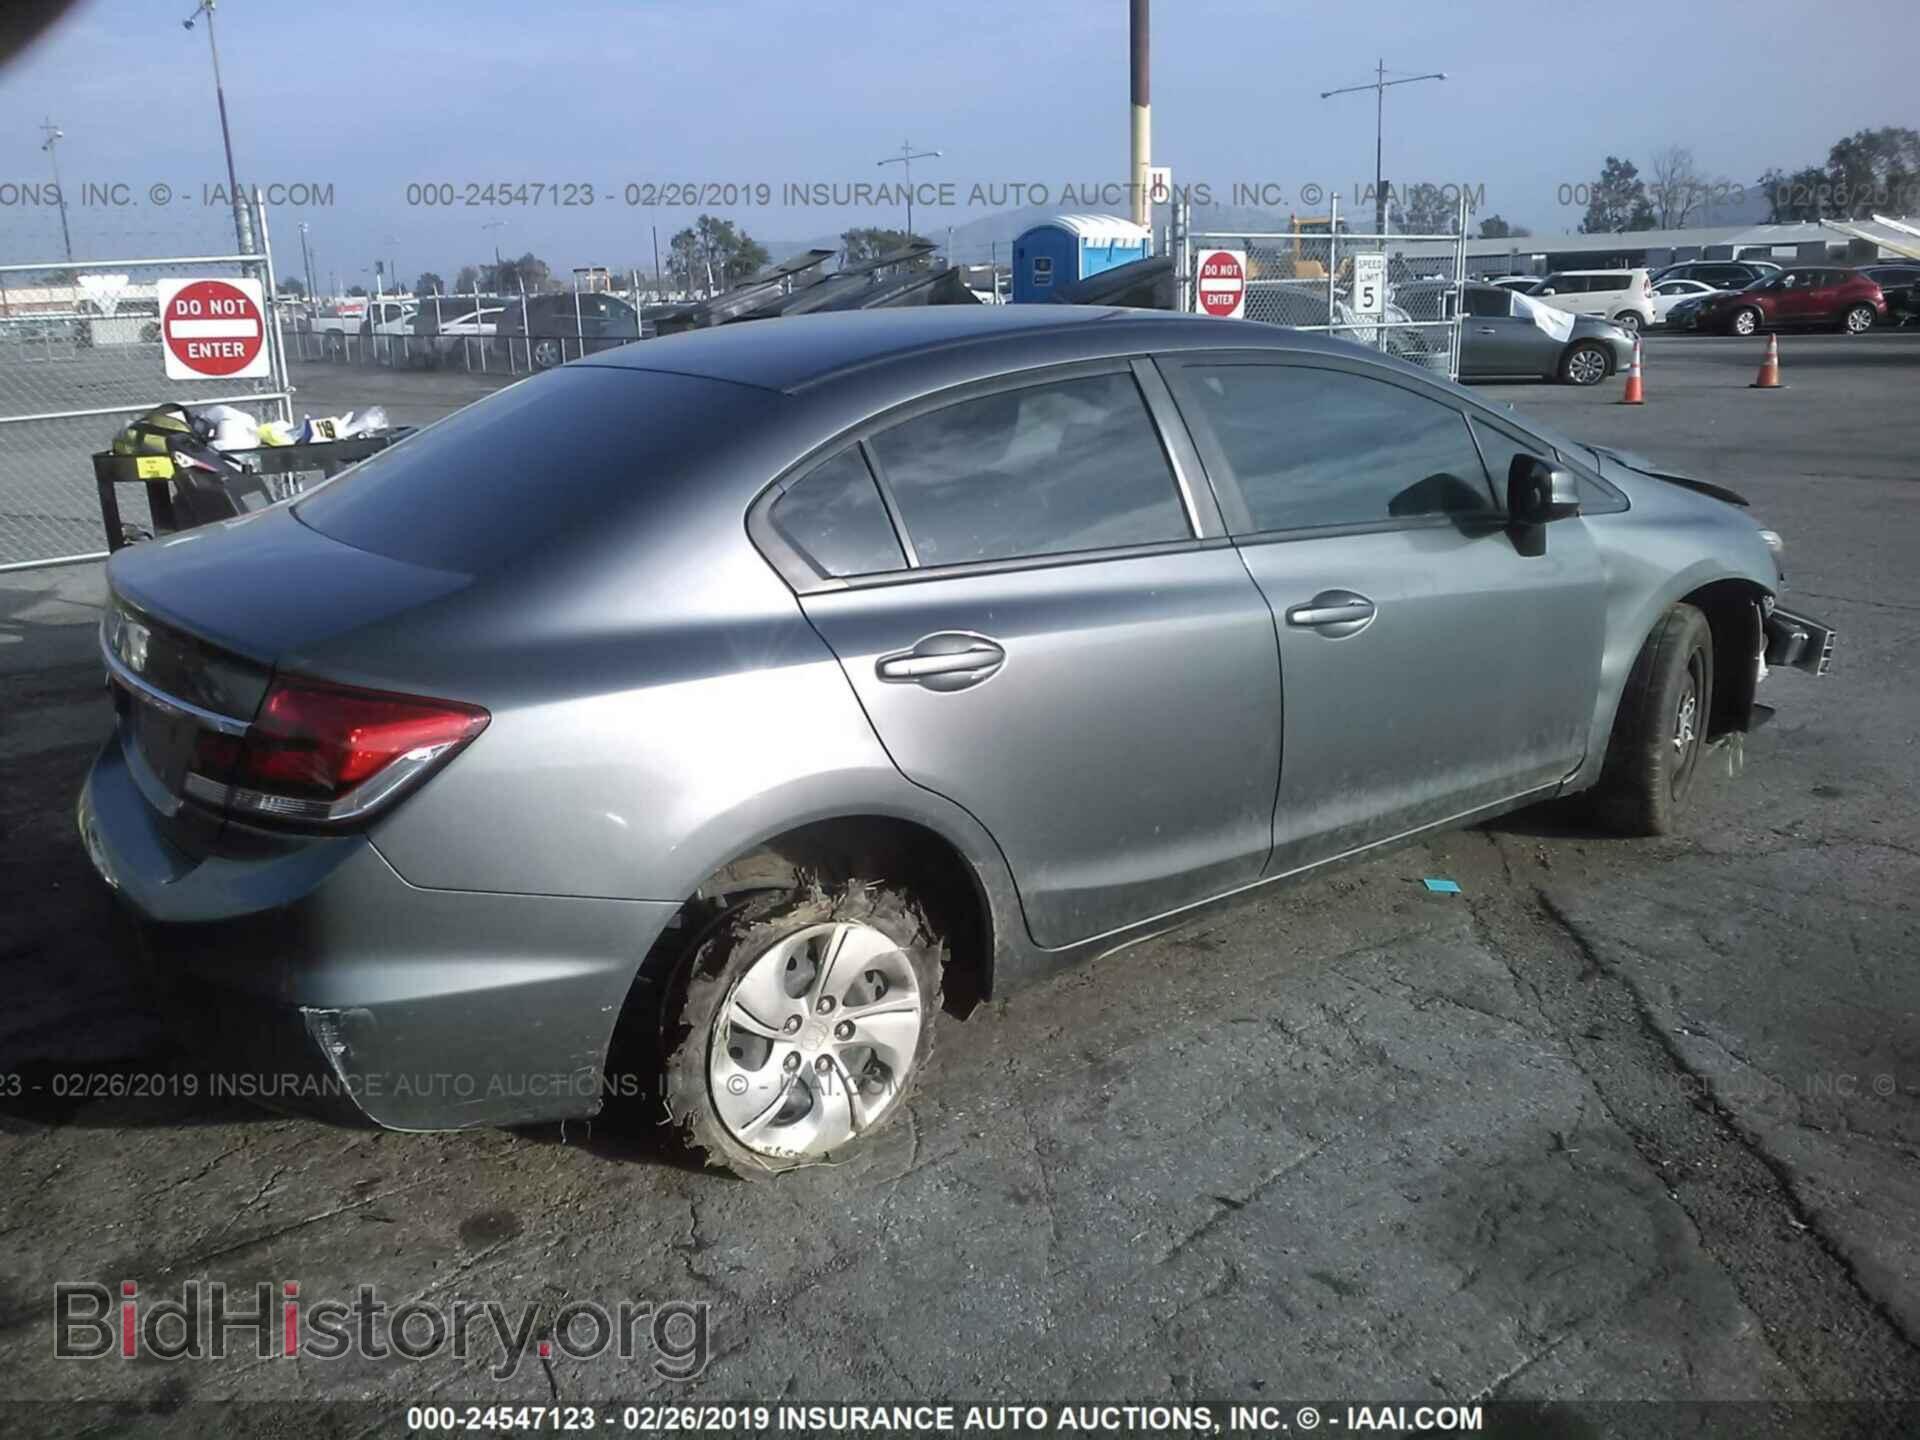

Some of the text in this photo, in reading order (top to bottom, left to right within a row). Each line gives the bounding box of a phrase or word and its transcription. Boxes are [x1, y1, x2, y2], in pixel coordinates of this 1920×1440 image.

[1205, 264, 1239, 276] DO NOT
[1207, 293, 1234, 305] ENTER
[1363, 286, 1375, 308] 5
[175, 298, 248, 316] DO NOT
[187, 341, 246, 358] ENTER
